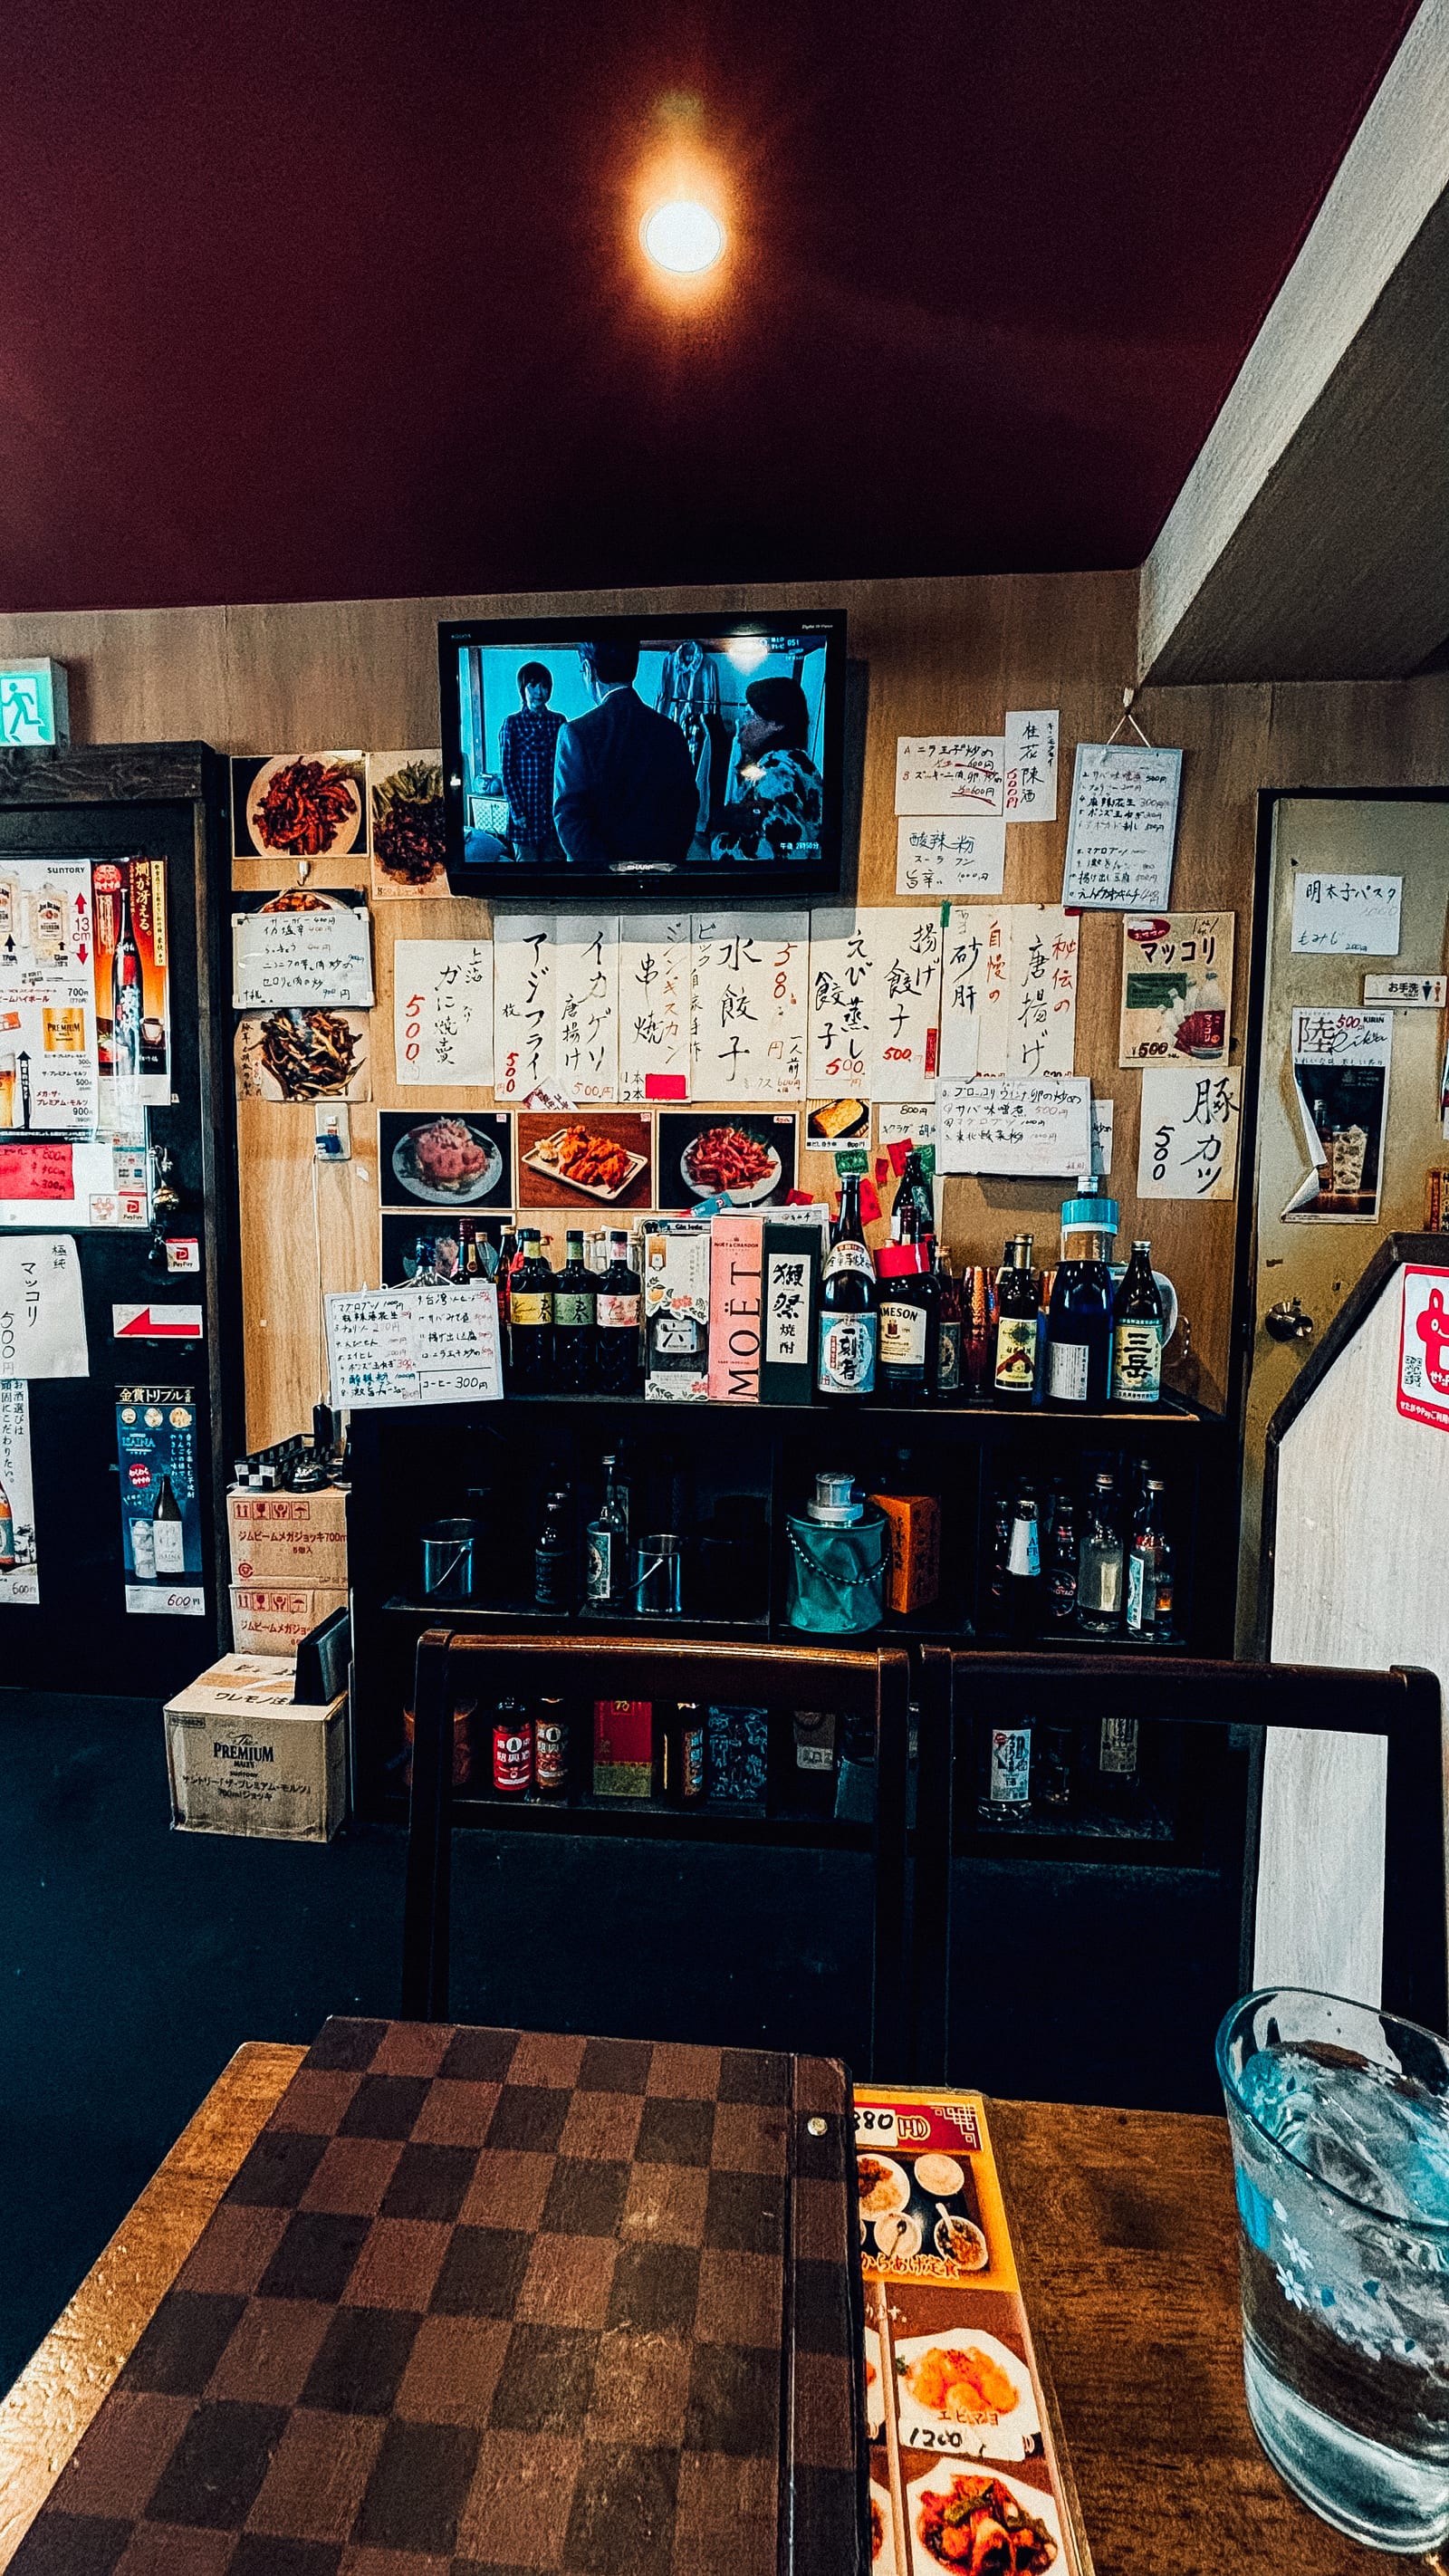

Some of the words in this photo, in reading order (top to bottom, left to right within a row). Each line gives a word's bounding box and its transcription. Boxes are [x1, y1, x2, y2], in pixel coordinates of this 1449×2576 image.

[1019, 721, 1045, 803] 桂花陳酒
[72, 932, 91, 942] cm
[75, 918, 90, 932] 13
[908, 922, 940, 988] 揚げ
[986, 920, 1006, 1003] 自慢の
[1140, 936, 1215, 966] マッコリ
[949, 937, 983, 1014] 砂肝
[1051, 933, 1077, 1014] 秘伝の
[1388, 982, 1419, 994] お手洗
[0, 995, 50, 1004] ームハイボール
[523, 932, 550, 1081] アジフライ
[632, 952, 665, 1045] 串焼
[716, 934, 763, 1081] 水餃子
[815, 970, 847, 1050] 餃子
[840, 929, 873, 1061] えび蒸し
[883, 957, 922, 1039] 餃子
[1017, 935, 1050, 1077] 唐揚げ
[48, 1023, 81, 1033] PREMIUM
[1297, 1016, 1336, 1055] 陸
[787, 1035, 803, 1080] 一人前
[623, 1089, 645, 1101] 2本
[1180, 1076, 1241, 1195] 豚カツ
[21, 1262, 40, 1328] マッコリ
[879, 1307, 918, 1322] AMESON
[660, 1322, 692, 1349] 六
[724, 1261, 761, 1399] MOËT
[779, 1323, 796, 1355] 焼酎
[838, 1327, 858, 1381] 一刻者
[1121, 1332, 1153, 1379] 三岳
[422, 1379, 452, 1389] コーヒー
[455, 1376, 488, 1390] 300円
[1400, 1401, 1449, 1425] せたがやPayご利用
[214, 1692, 293, 1706] ワレモノ注
[213, 1742, 274, 1763] PREMIUM
[228, 1732, 259, 1746] The
[909, 2427, 964, 2448] 1200
[937, 2410, 1000, 2427] エビマヨ
